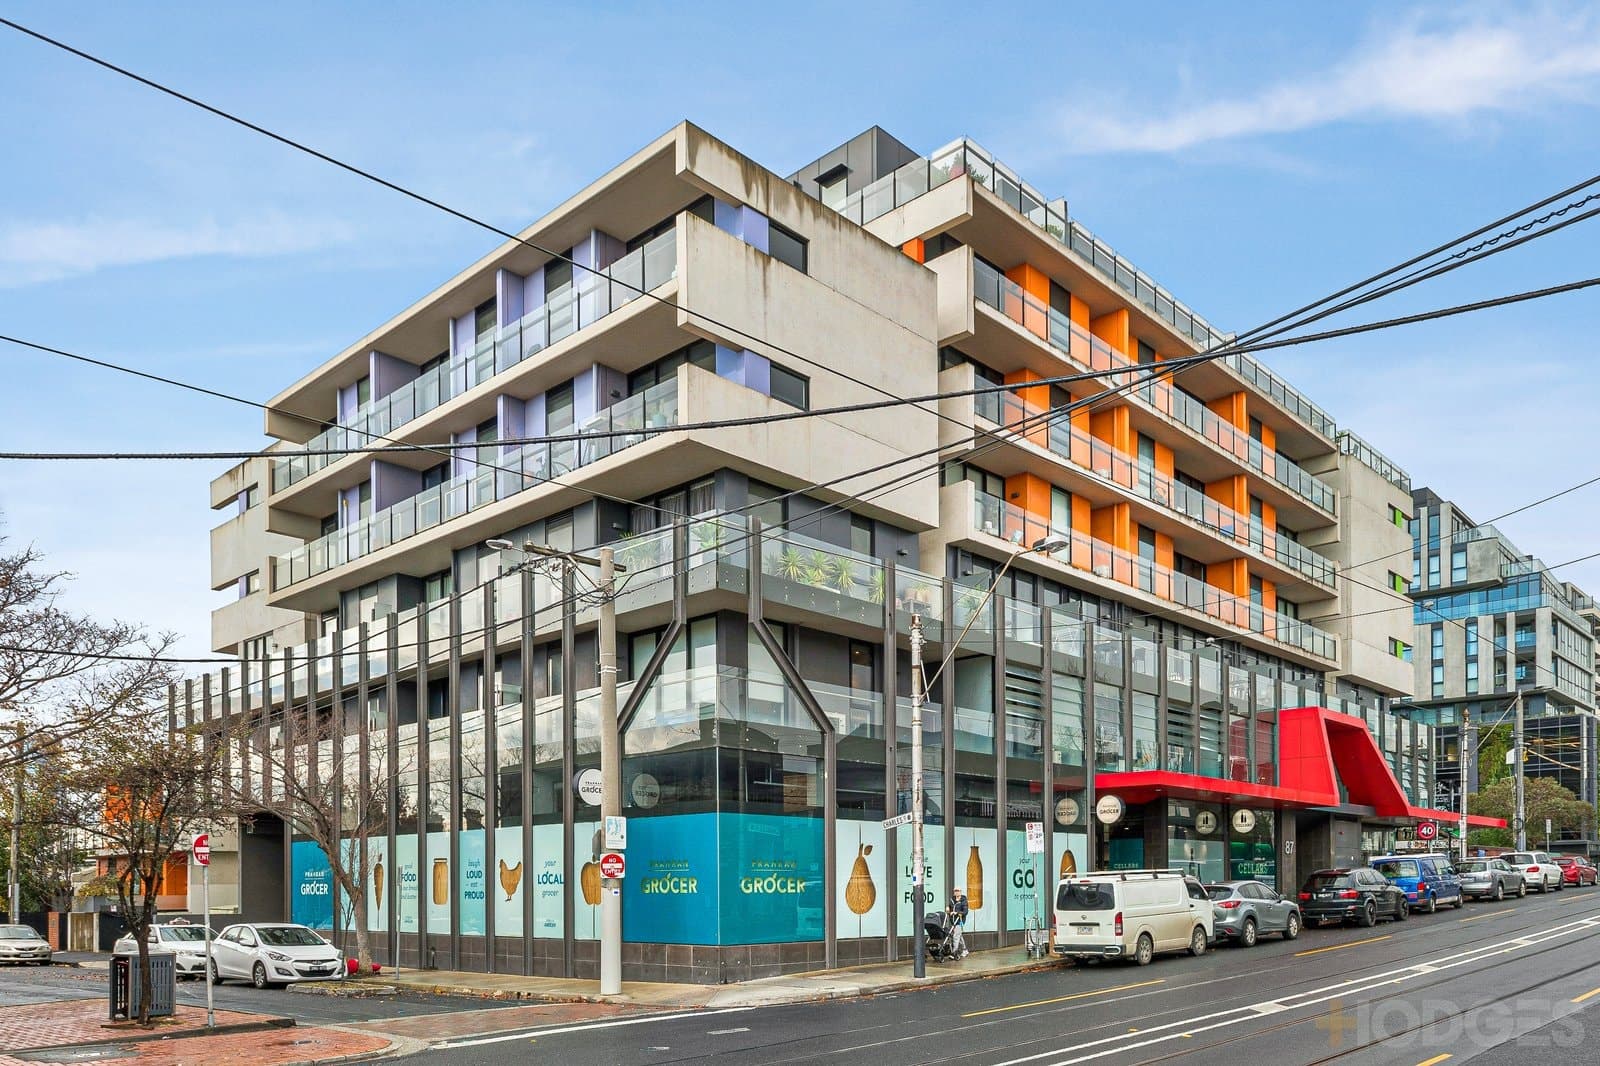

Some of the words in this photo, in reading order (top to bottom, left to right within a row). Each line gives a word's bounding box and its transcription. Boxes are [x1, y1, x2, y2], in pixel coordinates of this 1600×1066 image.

[1421, 826, 1433, 835] 40
[1285, 841, 1295, 855] 87
[1238, 862, 1268, 874] CELLARS
[466, 870, 483, 879] LOUD
[1012, 869, 1035, 889] GO
[464, 891, 485, 900] PROUD
